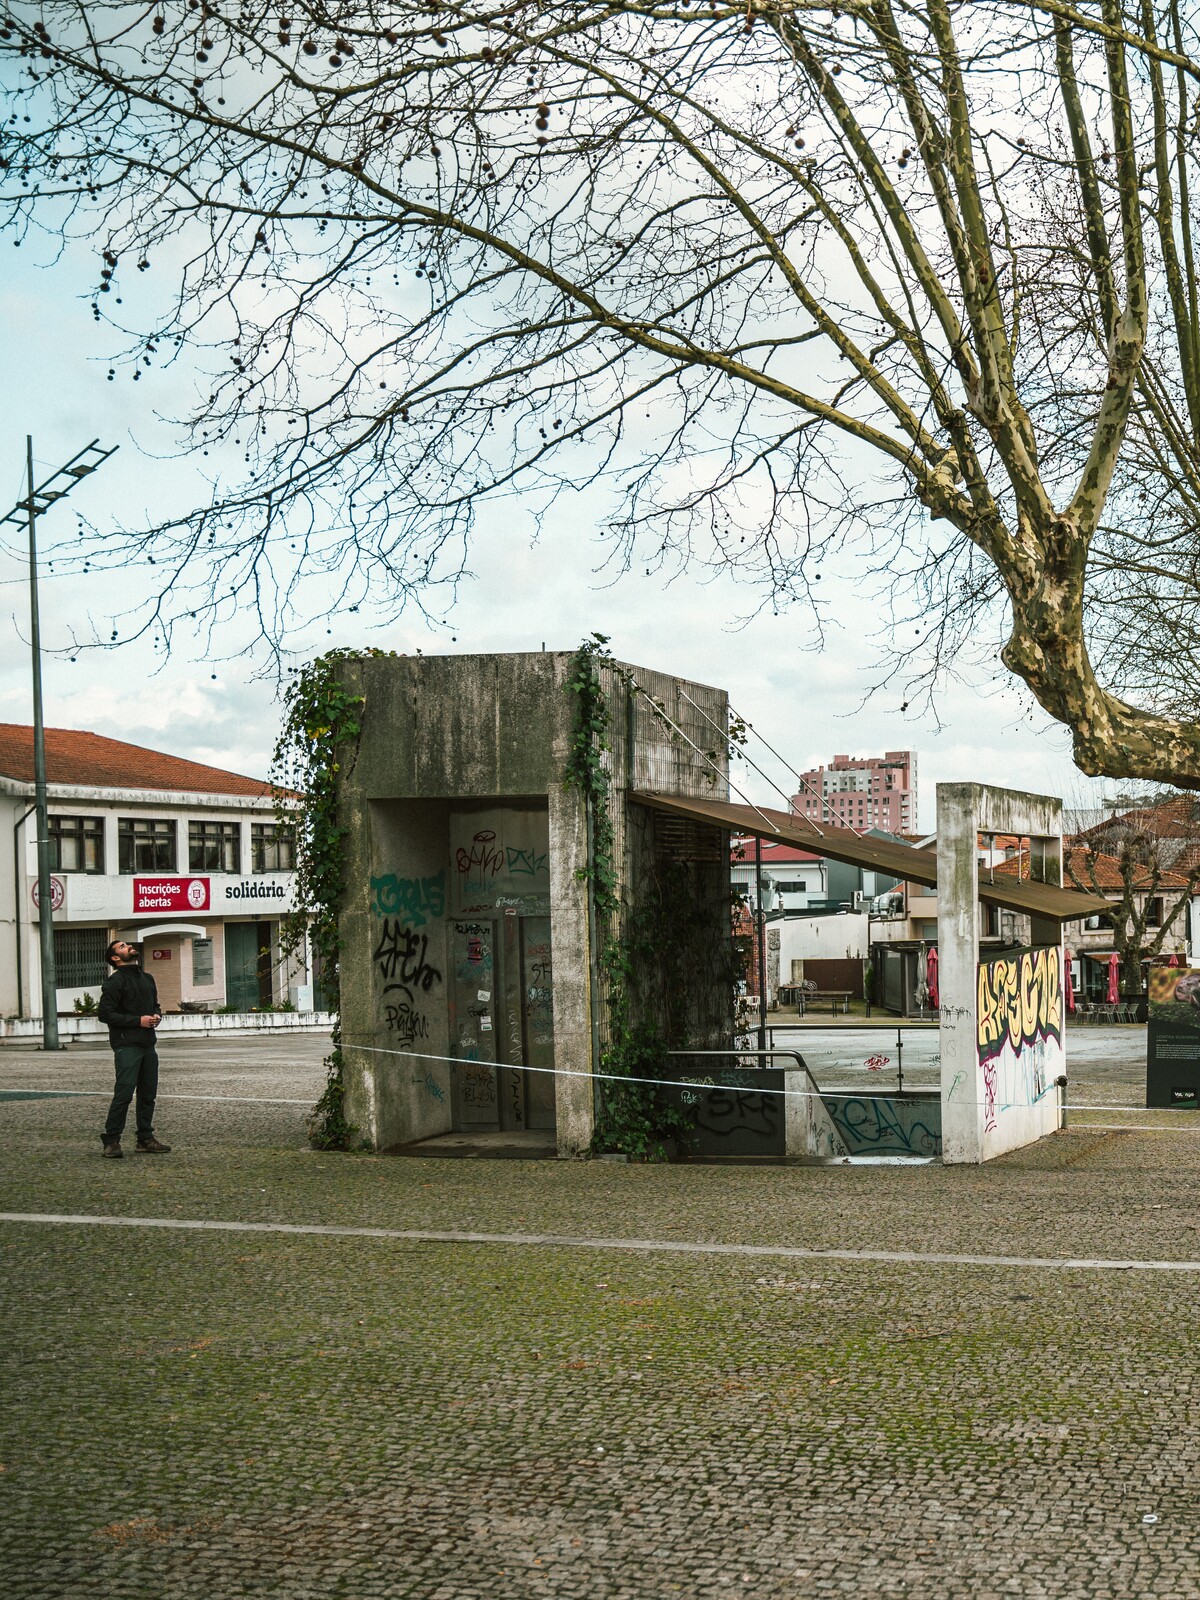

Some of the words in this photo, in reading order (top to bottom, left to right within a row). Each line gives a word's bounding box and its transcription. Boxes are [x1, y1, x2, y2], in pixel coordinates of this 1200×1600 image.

[138, 883, 181, 896] Inscrições
[225, 880, 284, 899] solidária
[138, 897, 171, 908] abertas
